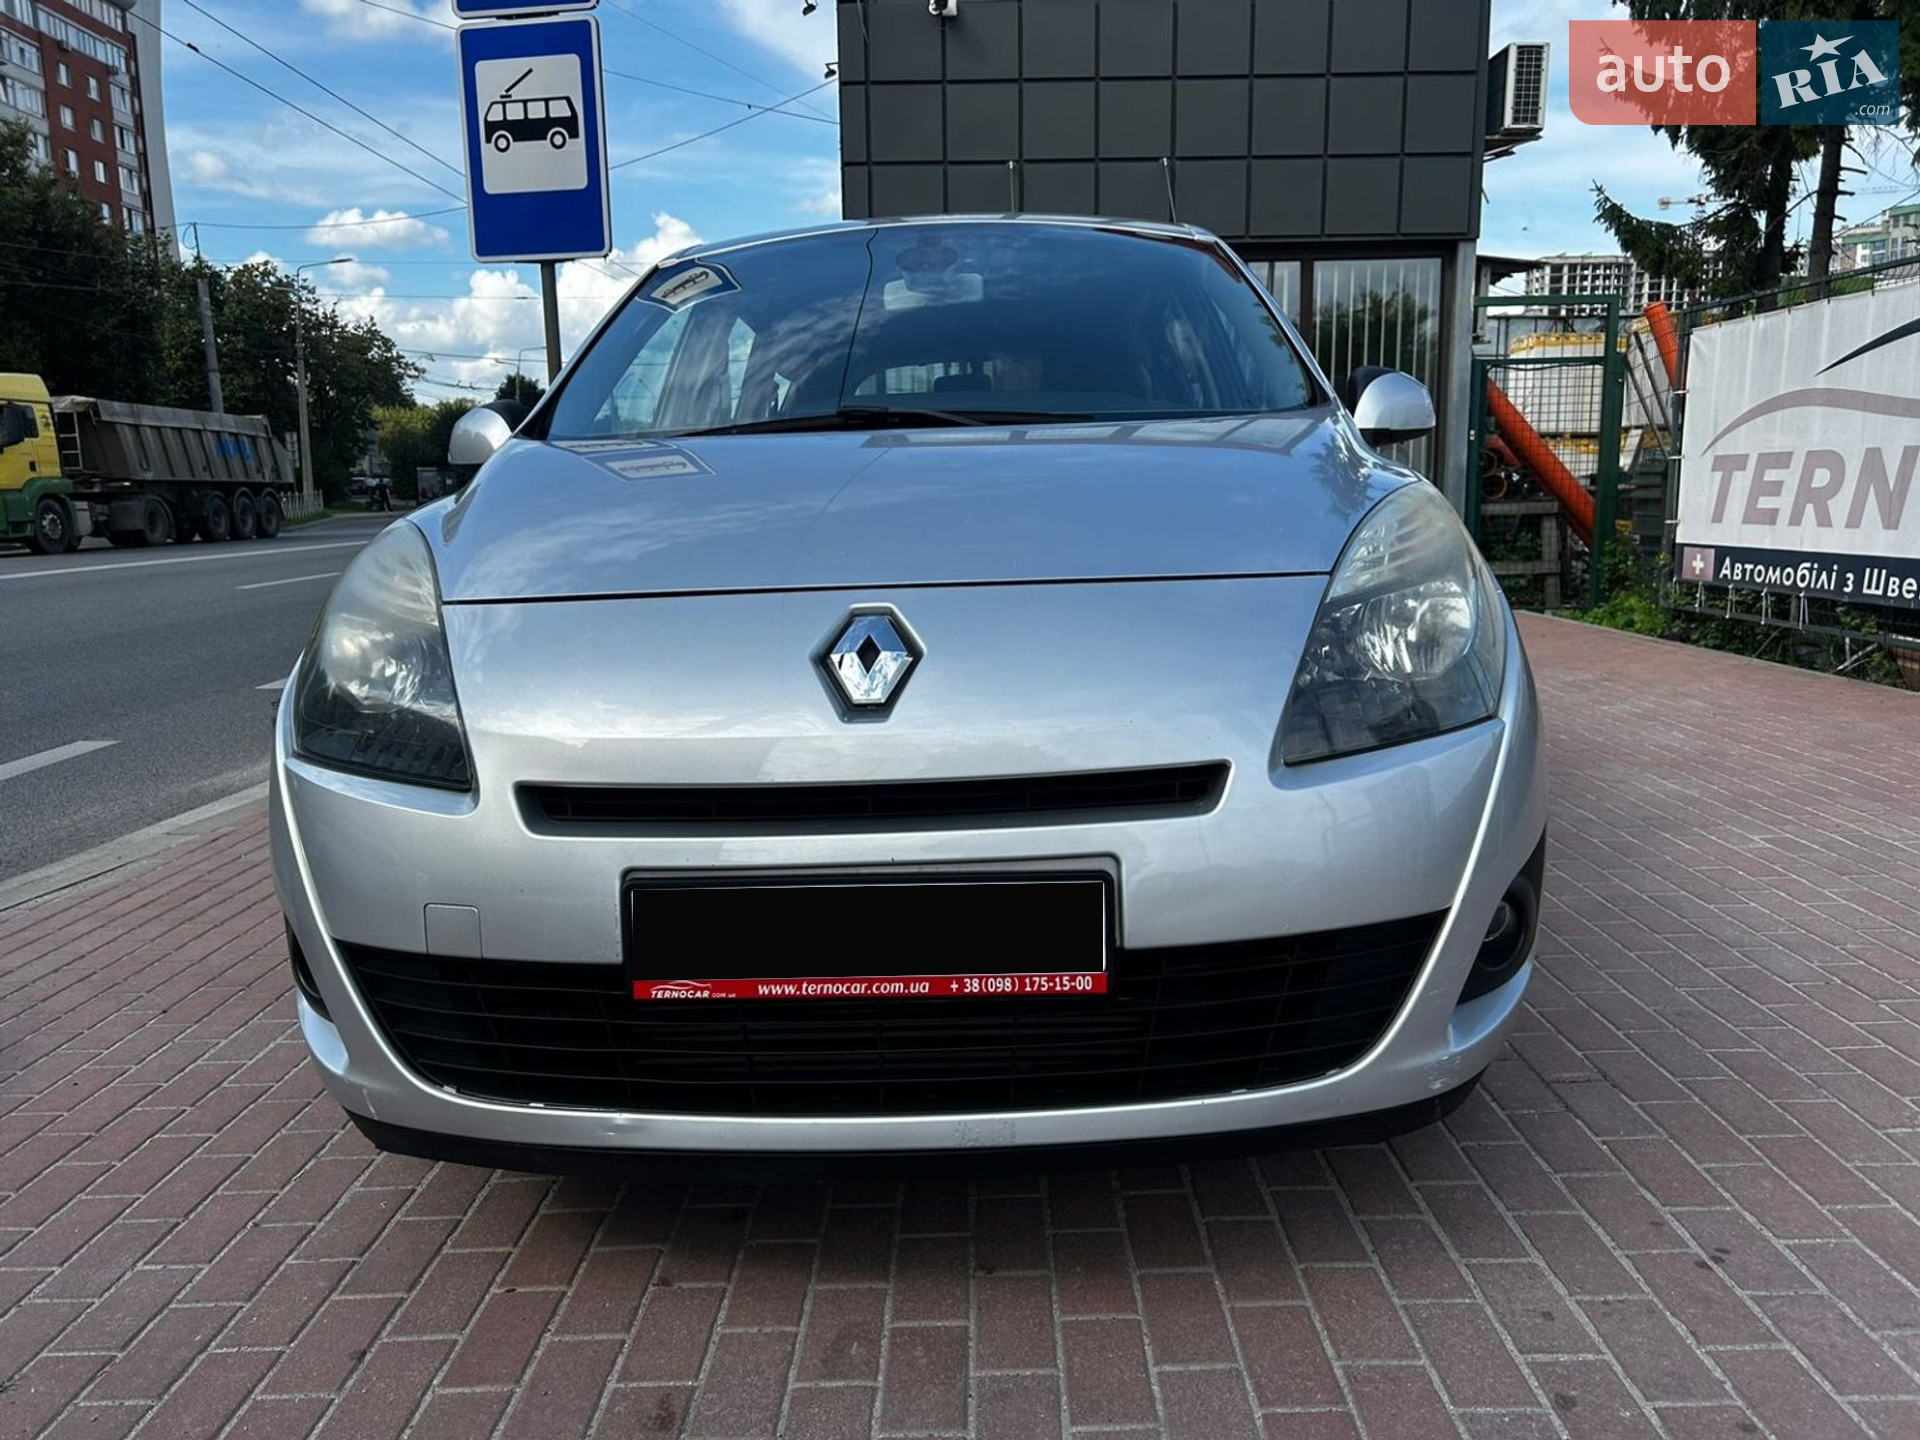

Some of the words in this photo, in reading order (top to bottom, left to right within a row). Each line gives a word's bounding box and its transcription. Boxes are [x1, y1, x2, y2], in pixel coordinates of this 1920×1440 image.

[1710, 445, 1920, 531] TERN
[1719, 556, 1839, 591] Автомобілі
[1843, 572, 1854, 593] з
[1862, 567, 1920, 600] Шве
[650, 990, 710, 999] TERNOCAR
[757, 981, 930, 996] www.ternocar.com.ua
[1024, 975, 1093, 992] 175-15-00
